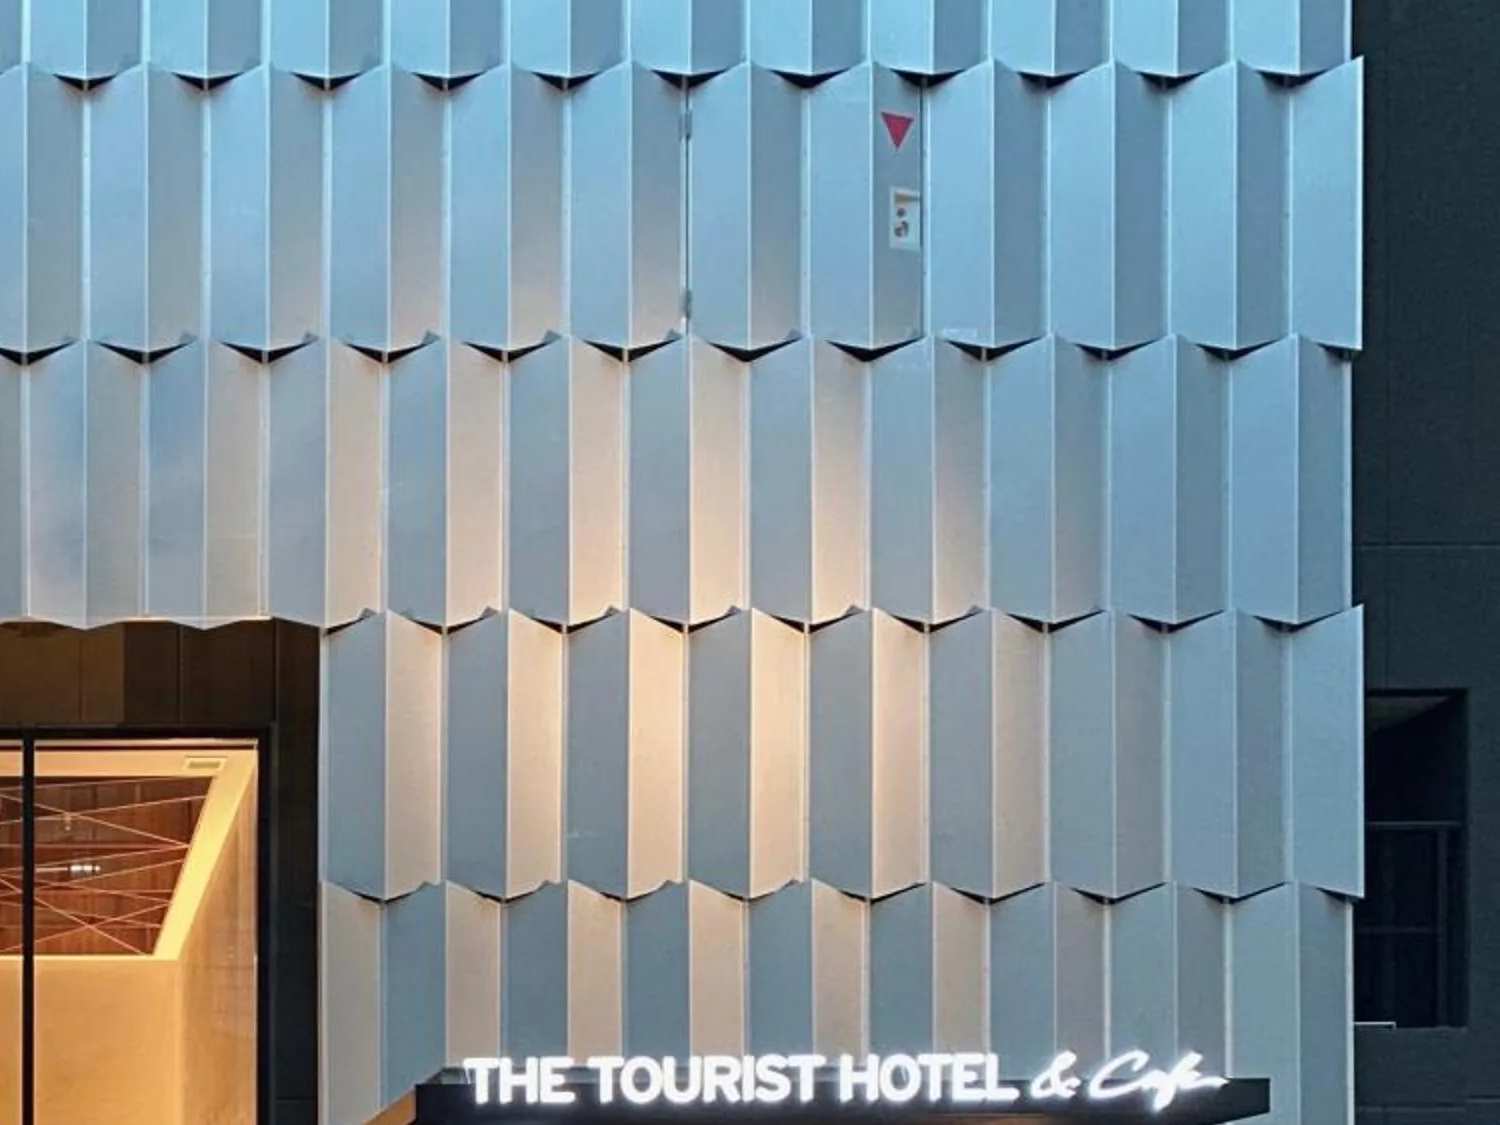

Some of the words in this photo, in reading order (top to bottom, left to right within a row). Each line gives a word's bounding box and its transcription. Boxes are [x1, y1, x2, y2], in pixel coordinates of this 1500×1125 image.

[462, 1056, 576, 1104] THE
[586, 1053, 827, 1104] TOURIST
[839, 1052, 1020, 1103] HOTEL
[1030, 1050, 1081, 1099] &
